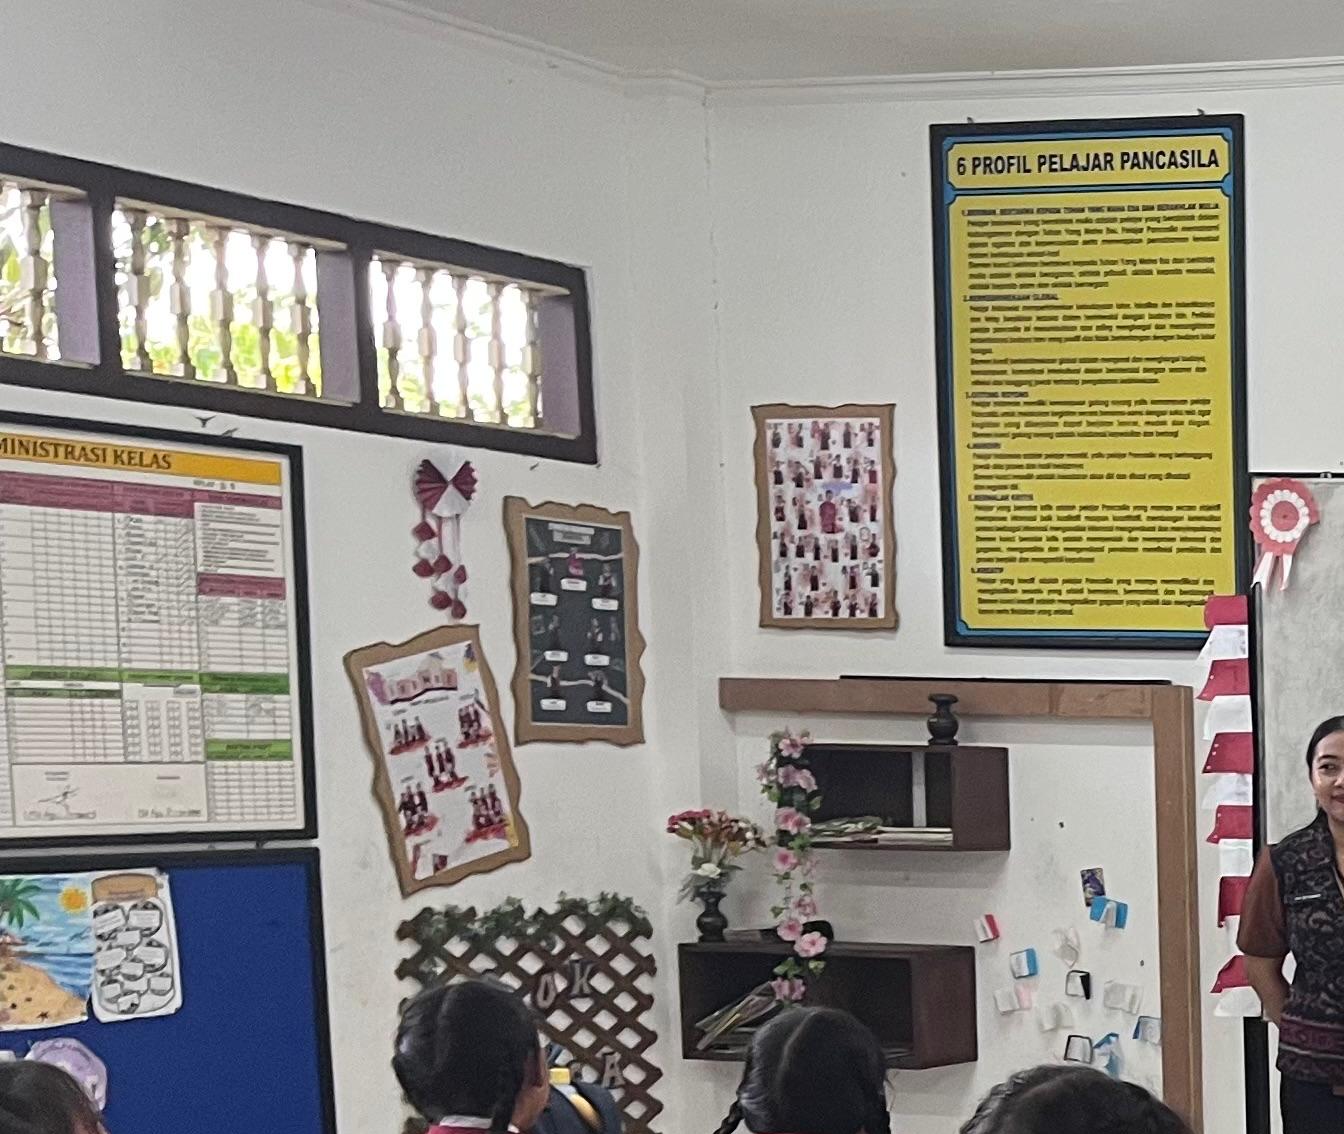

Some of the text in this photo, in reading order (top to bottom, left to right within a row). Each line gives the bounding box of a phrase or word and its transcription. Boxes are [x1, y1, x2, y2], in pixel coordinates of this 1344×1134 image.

[957, 149, 1219, 175] 6 PROFIL PELAJAR PANCASILA
[113, 449, 172, 470] KELAS
